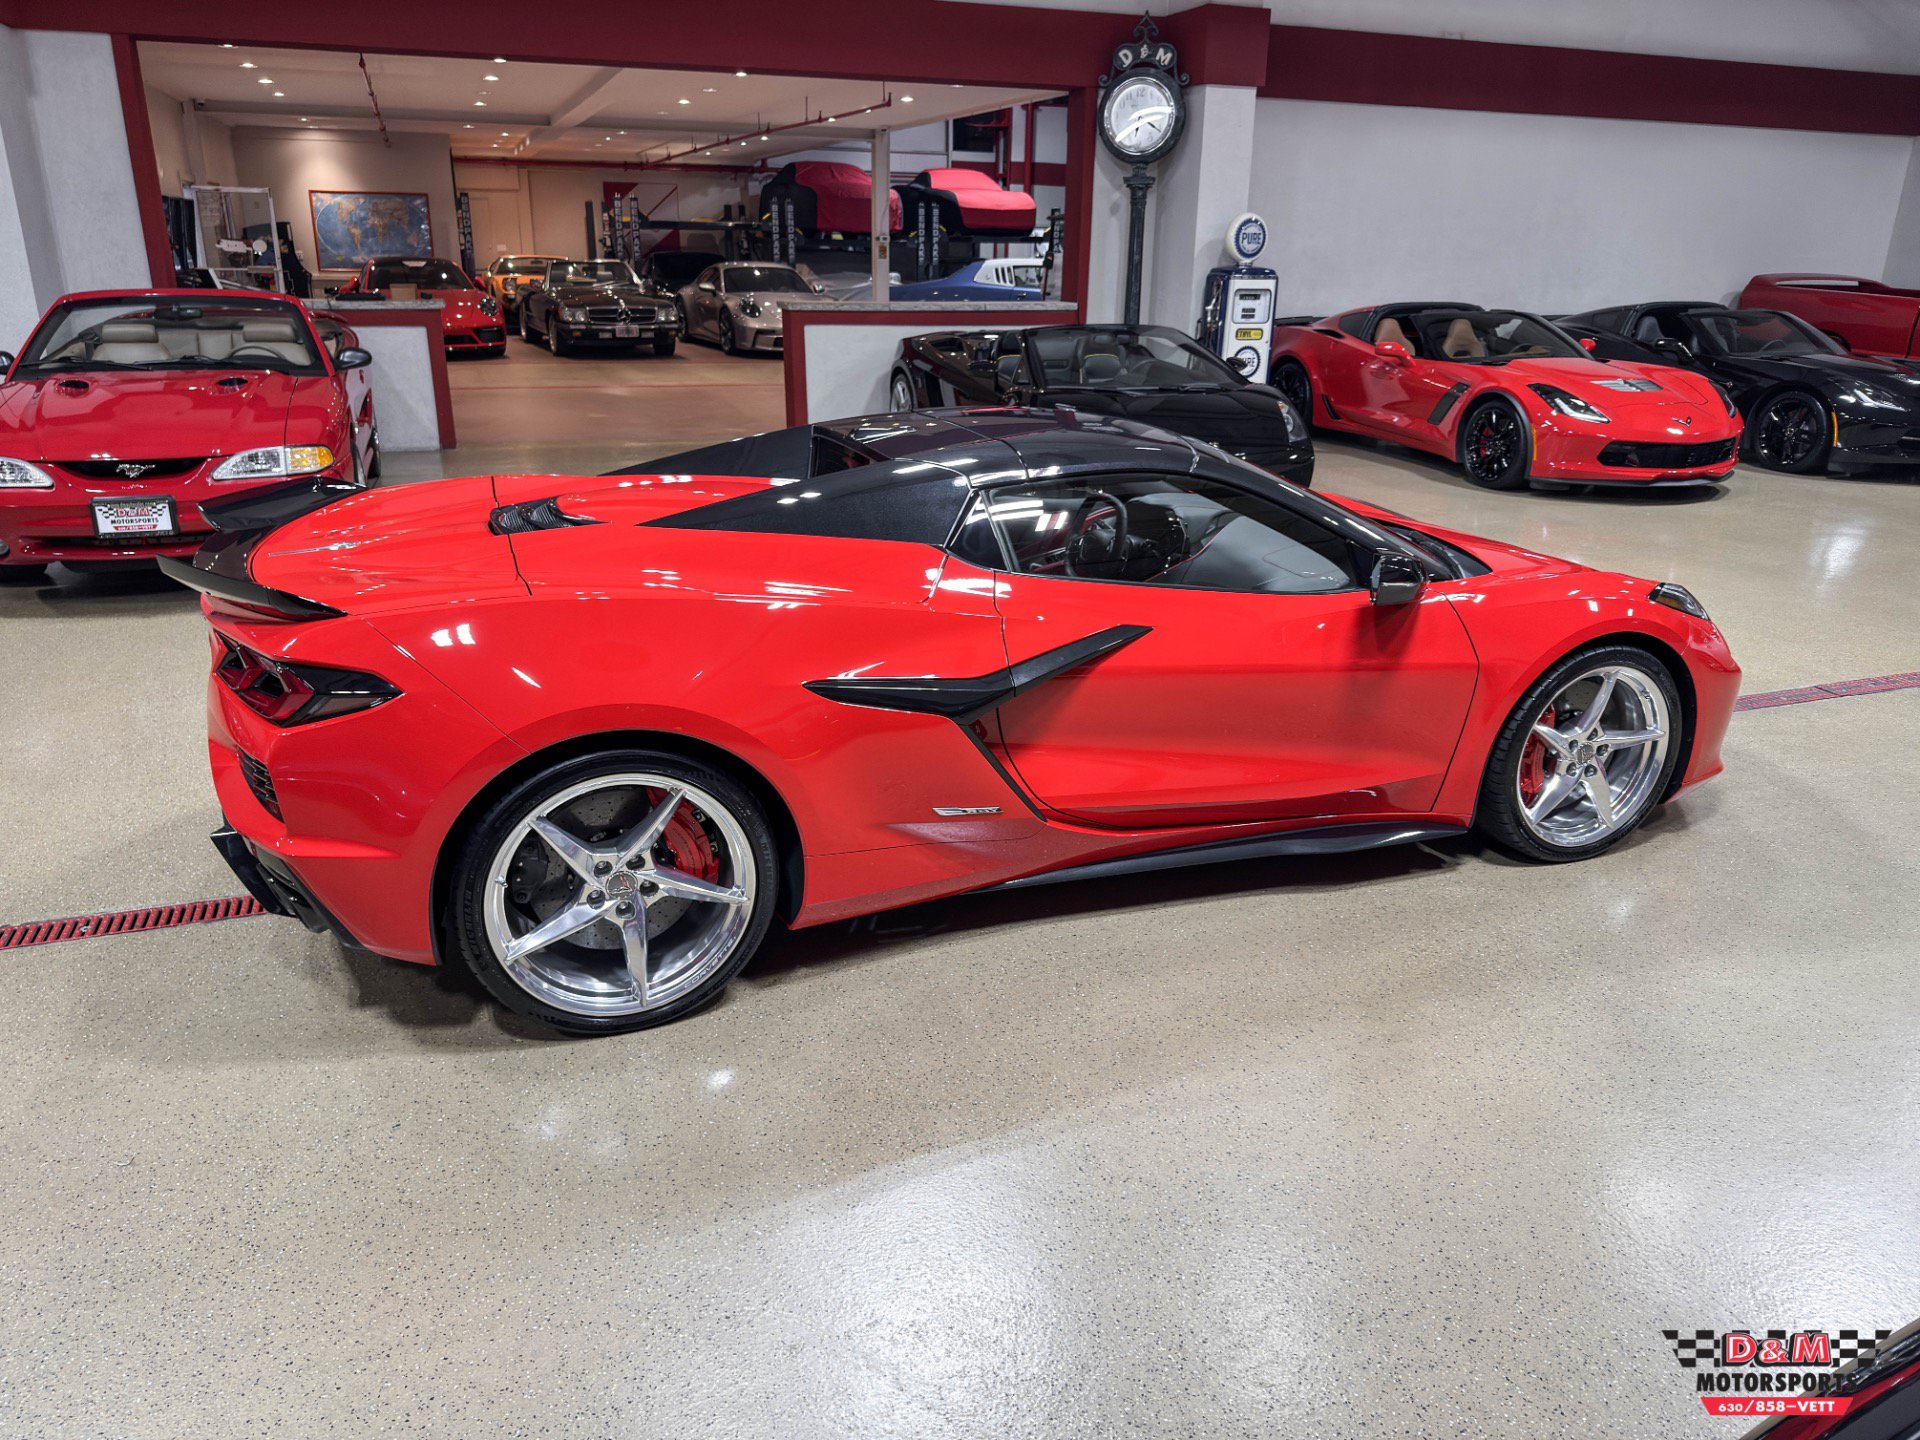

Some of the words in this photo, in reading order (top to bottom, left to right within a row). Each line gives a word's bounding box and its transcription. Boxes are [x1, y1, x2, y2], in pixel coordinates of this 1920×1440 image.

[1118, 49, 1133, 68] D
[1156, 47, 1173, 66] M
[1241, 232, 1262, 245] PURE
[684, 939, 733, 988] CORVETTE
